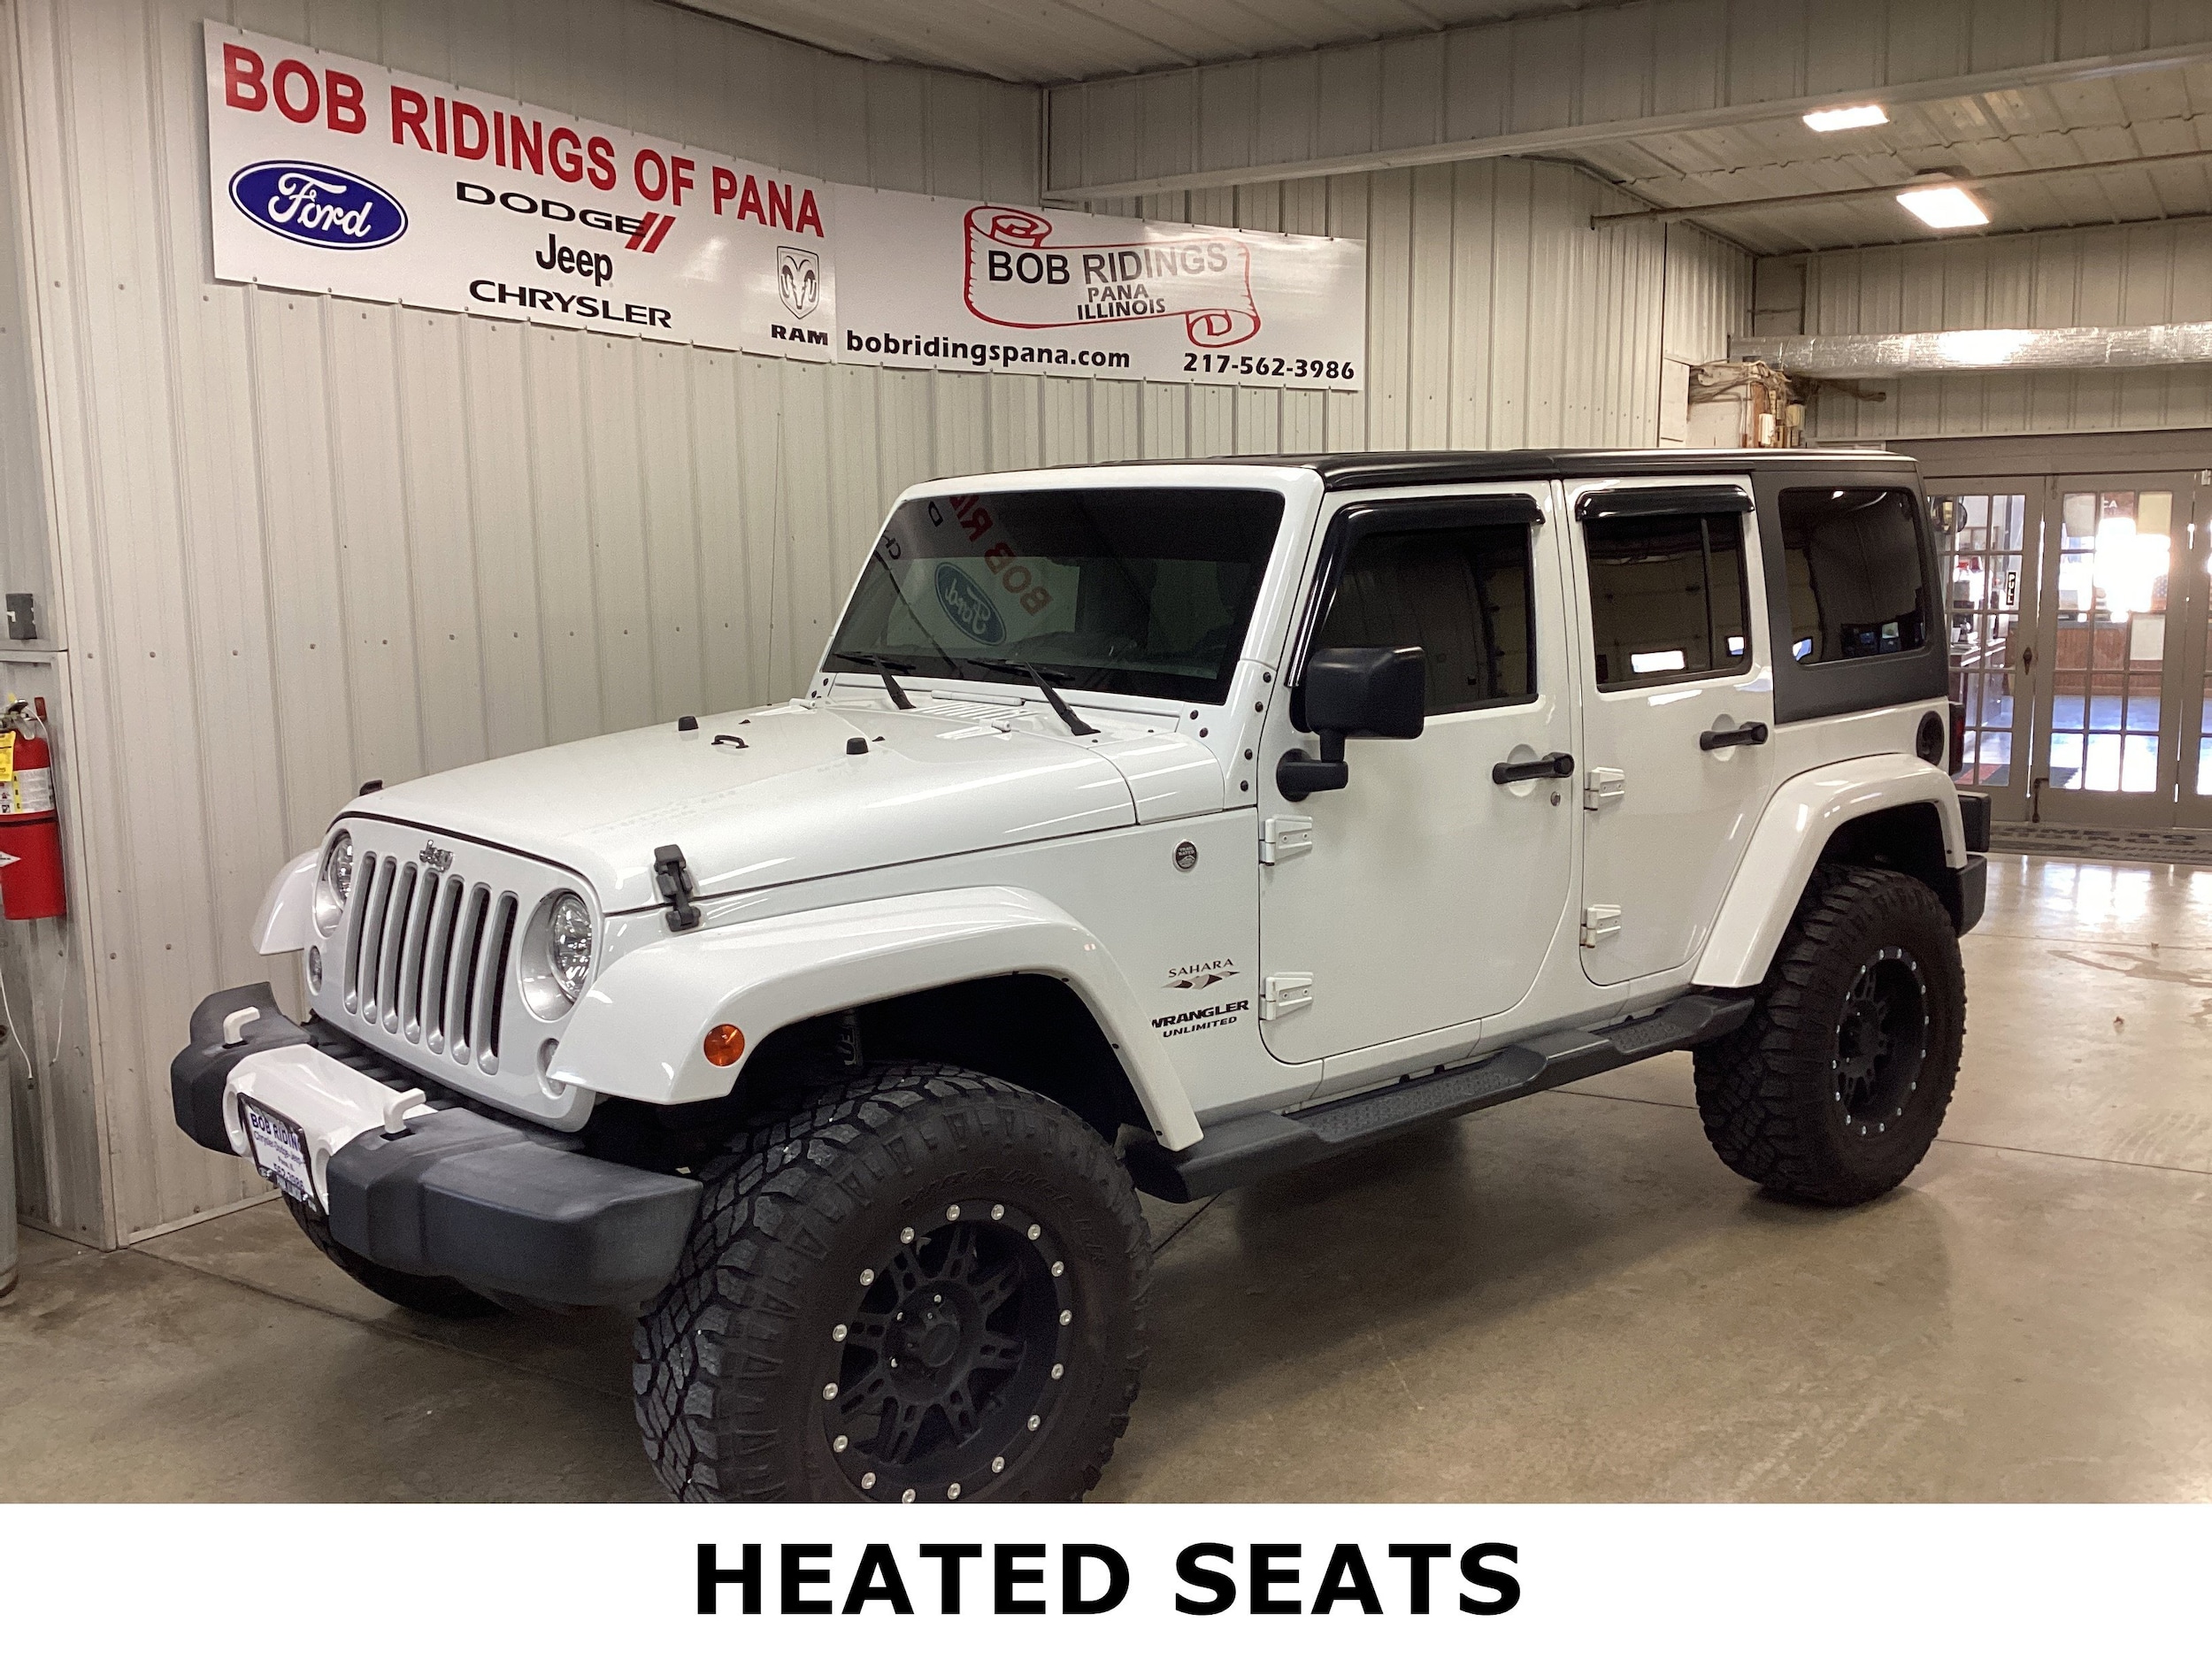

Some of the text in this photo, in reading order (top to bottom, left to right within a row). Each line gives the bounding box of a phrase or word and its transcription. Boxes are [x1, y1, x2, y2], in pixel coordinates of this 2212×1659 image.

[223, 42, 825, 237] BOB RIDINGS OF PANA
[268, 173, 372, 238] Ford
[457, 180, 646, 236] DODGE
[535, 234, 612, 286] Jeep
[987, 244, 1228, 285] BOB RIDINGS
[469, 280, 672, 328] CHRYSLER
[1087, 284, 1148, 303] PANA
[1077, 298, 1166, 320] ILLINOIS
[771, 324, 828, 346] RAM
[847, 330, 1131, 368] bobridingspana.com
[1183, 353, 1355, 380] 217-562-3986
[2007, 574, 2016, 603] PULL
[1168, 958, 1234, 978] SAHARA
[1151, 1000, 1249, 1028] WRANGLER
[1163, 1016, 1237, 1038] UNLIMITED
[250, 1113, 272, 1134] BOB
